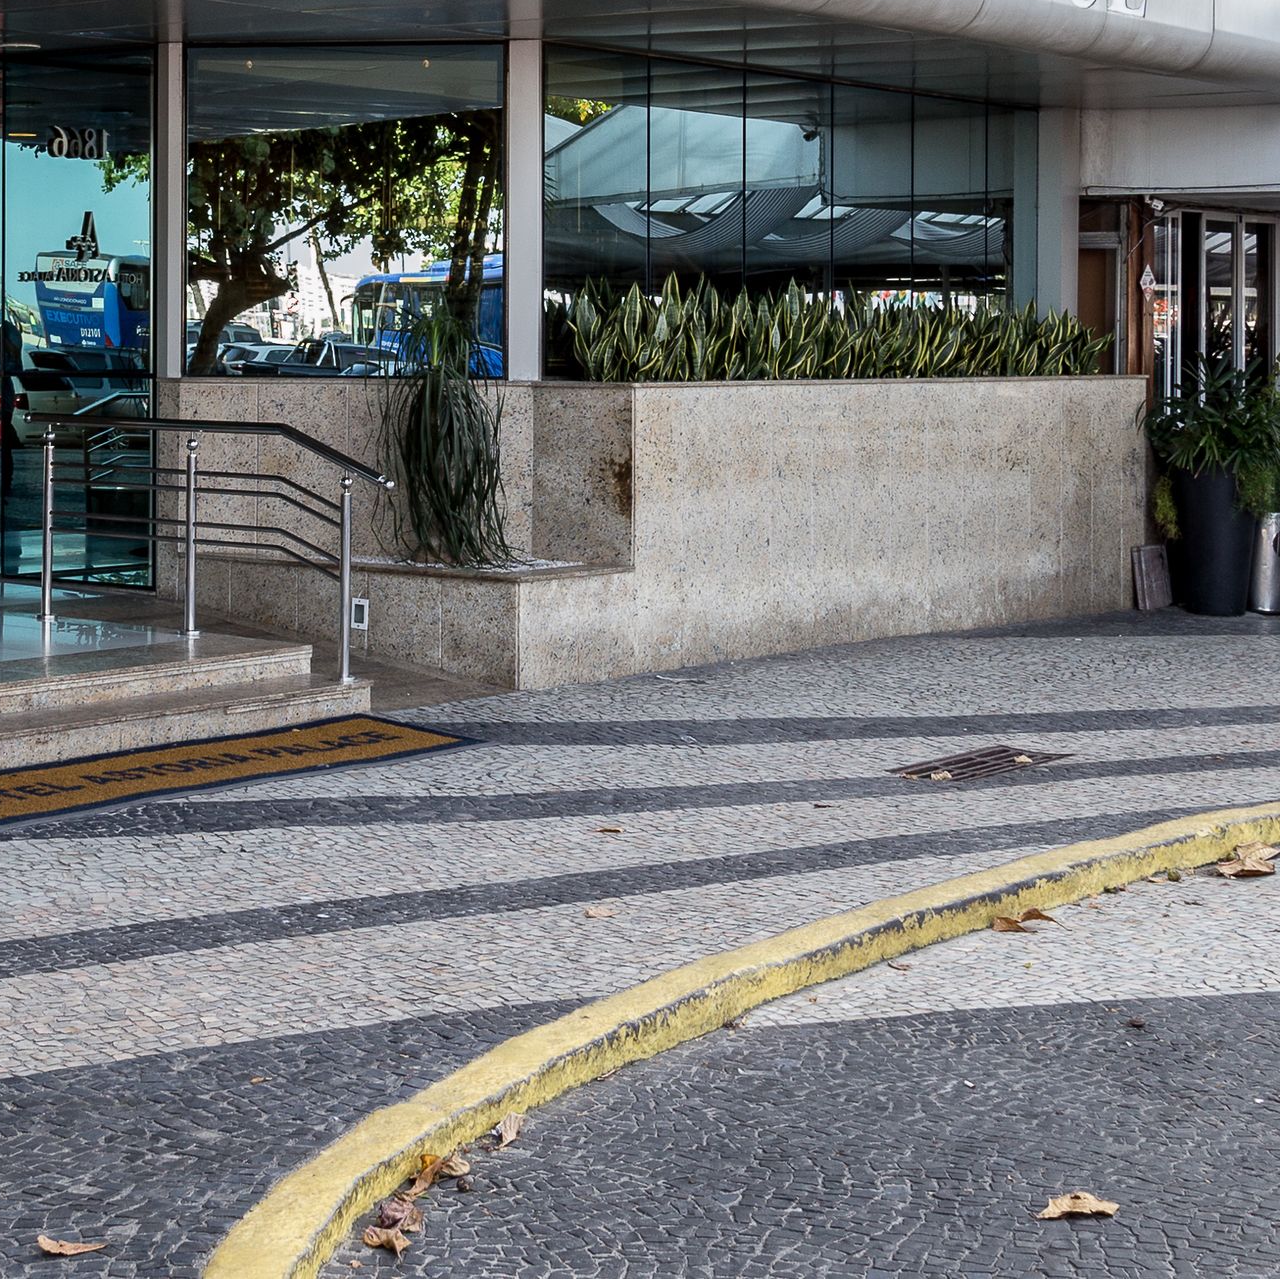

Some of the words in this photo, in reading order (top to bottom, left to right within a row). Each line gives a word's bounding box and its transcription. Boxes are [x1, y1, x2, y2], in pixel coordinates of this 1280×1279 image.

[45, 309, 99, 326] EXECUTIVO
[79, 752, 265, 786] ASTORIA
[248, 730, 404, 761] PALACE
